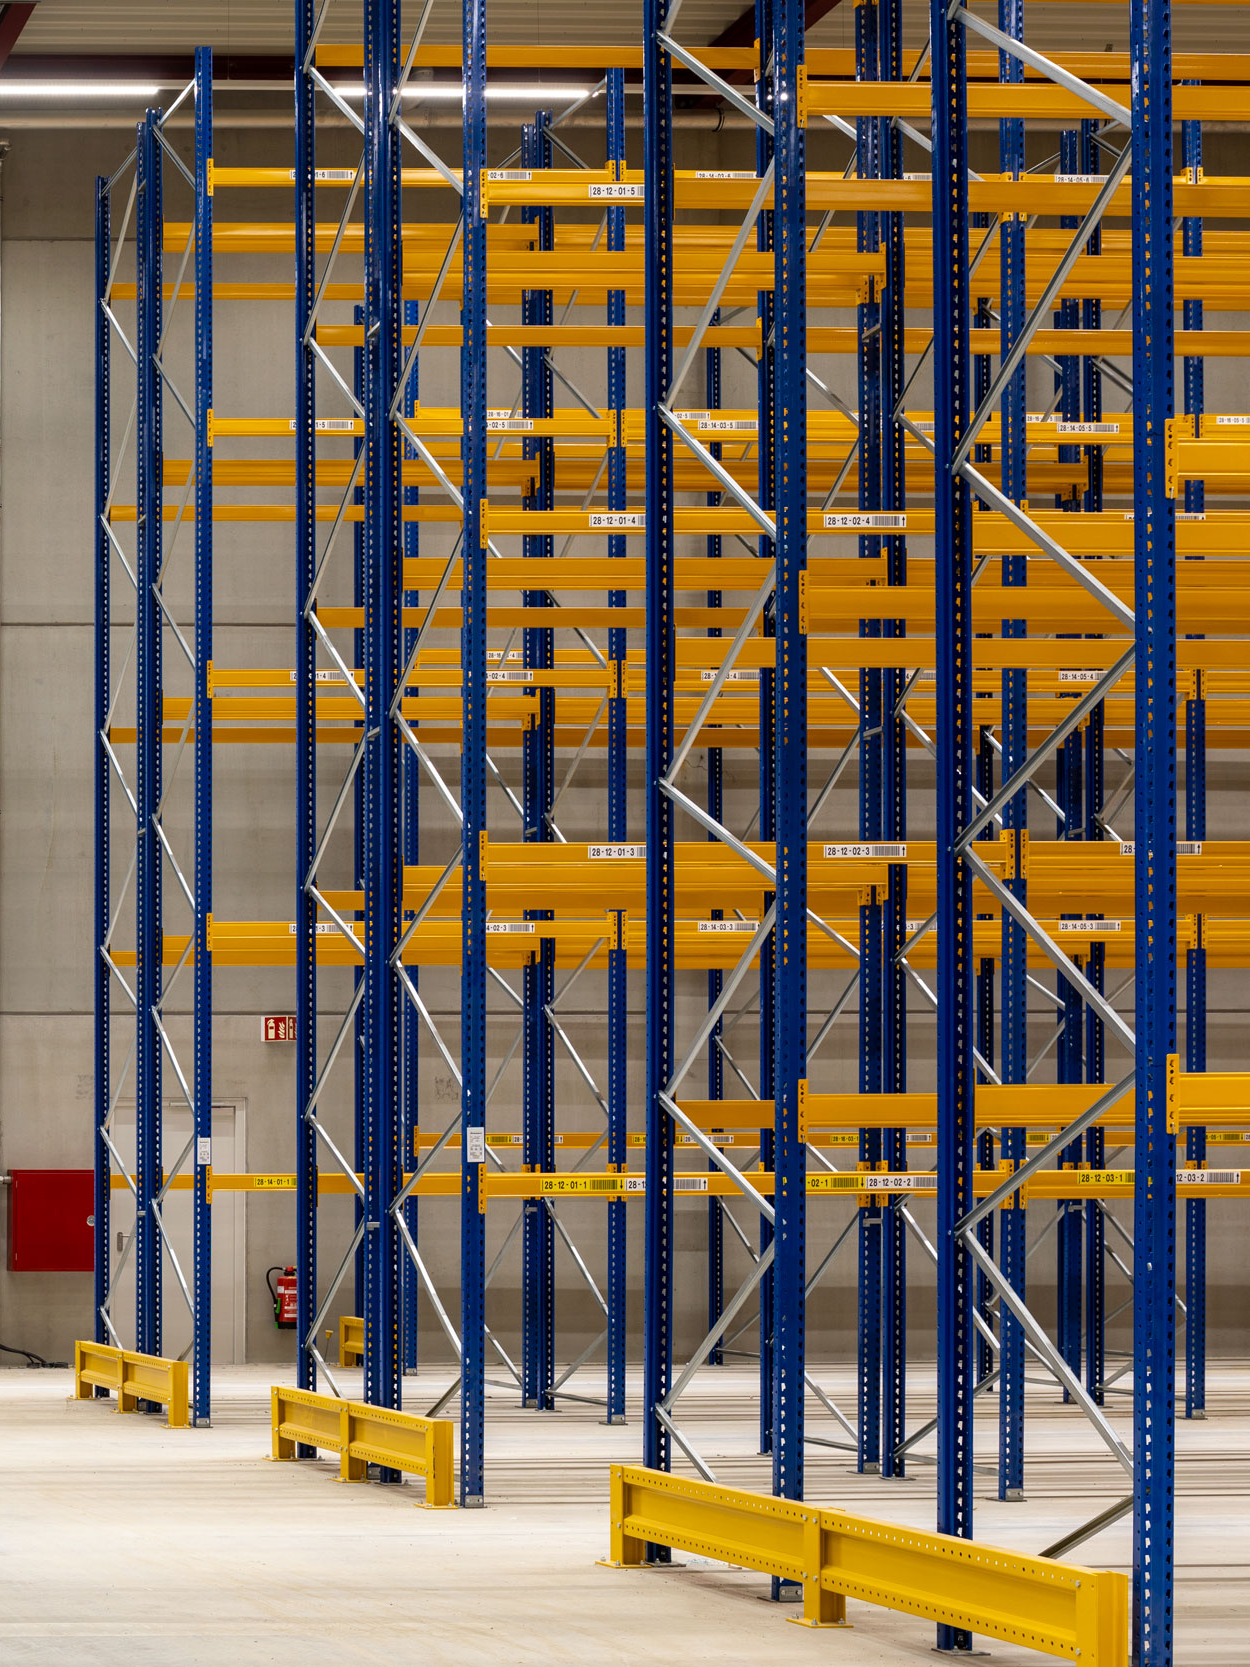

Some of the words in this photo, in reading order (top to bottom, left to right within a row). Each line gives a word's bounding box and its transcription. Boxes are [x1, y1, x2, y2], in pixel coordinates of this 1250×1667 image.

[592, 187, 636, 196] 28-12-01-5
[487, 421, 505, 429] -02-5
[700, 421, 734, 429] 28-14-03-5
[1060, 424, 1092, 432] 28-14-05-5
[592, 516, 636, 525] 28-12-01-4
[827, 516, 870, 526] 28-12-02-4
[592, 847, 635, 856] 28-12-01-3
[827, 847, 870, 856] 28-12-02-3
[1061, 923, 1094, 931] 28-14-05-3
[257, 1178, 290, 1186] 28-14-01-1
[1081, 1173, 1123, 1183] 28-12-03-1
[1176, 1173, 1205, 1182] 12-03-2
[544, 1180, 587, 1190] 28-12-01-1
[807, 1178, 828, 1188] -02-1
[869, 1178, 912, 1187] 28-12-02-2
